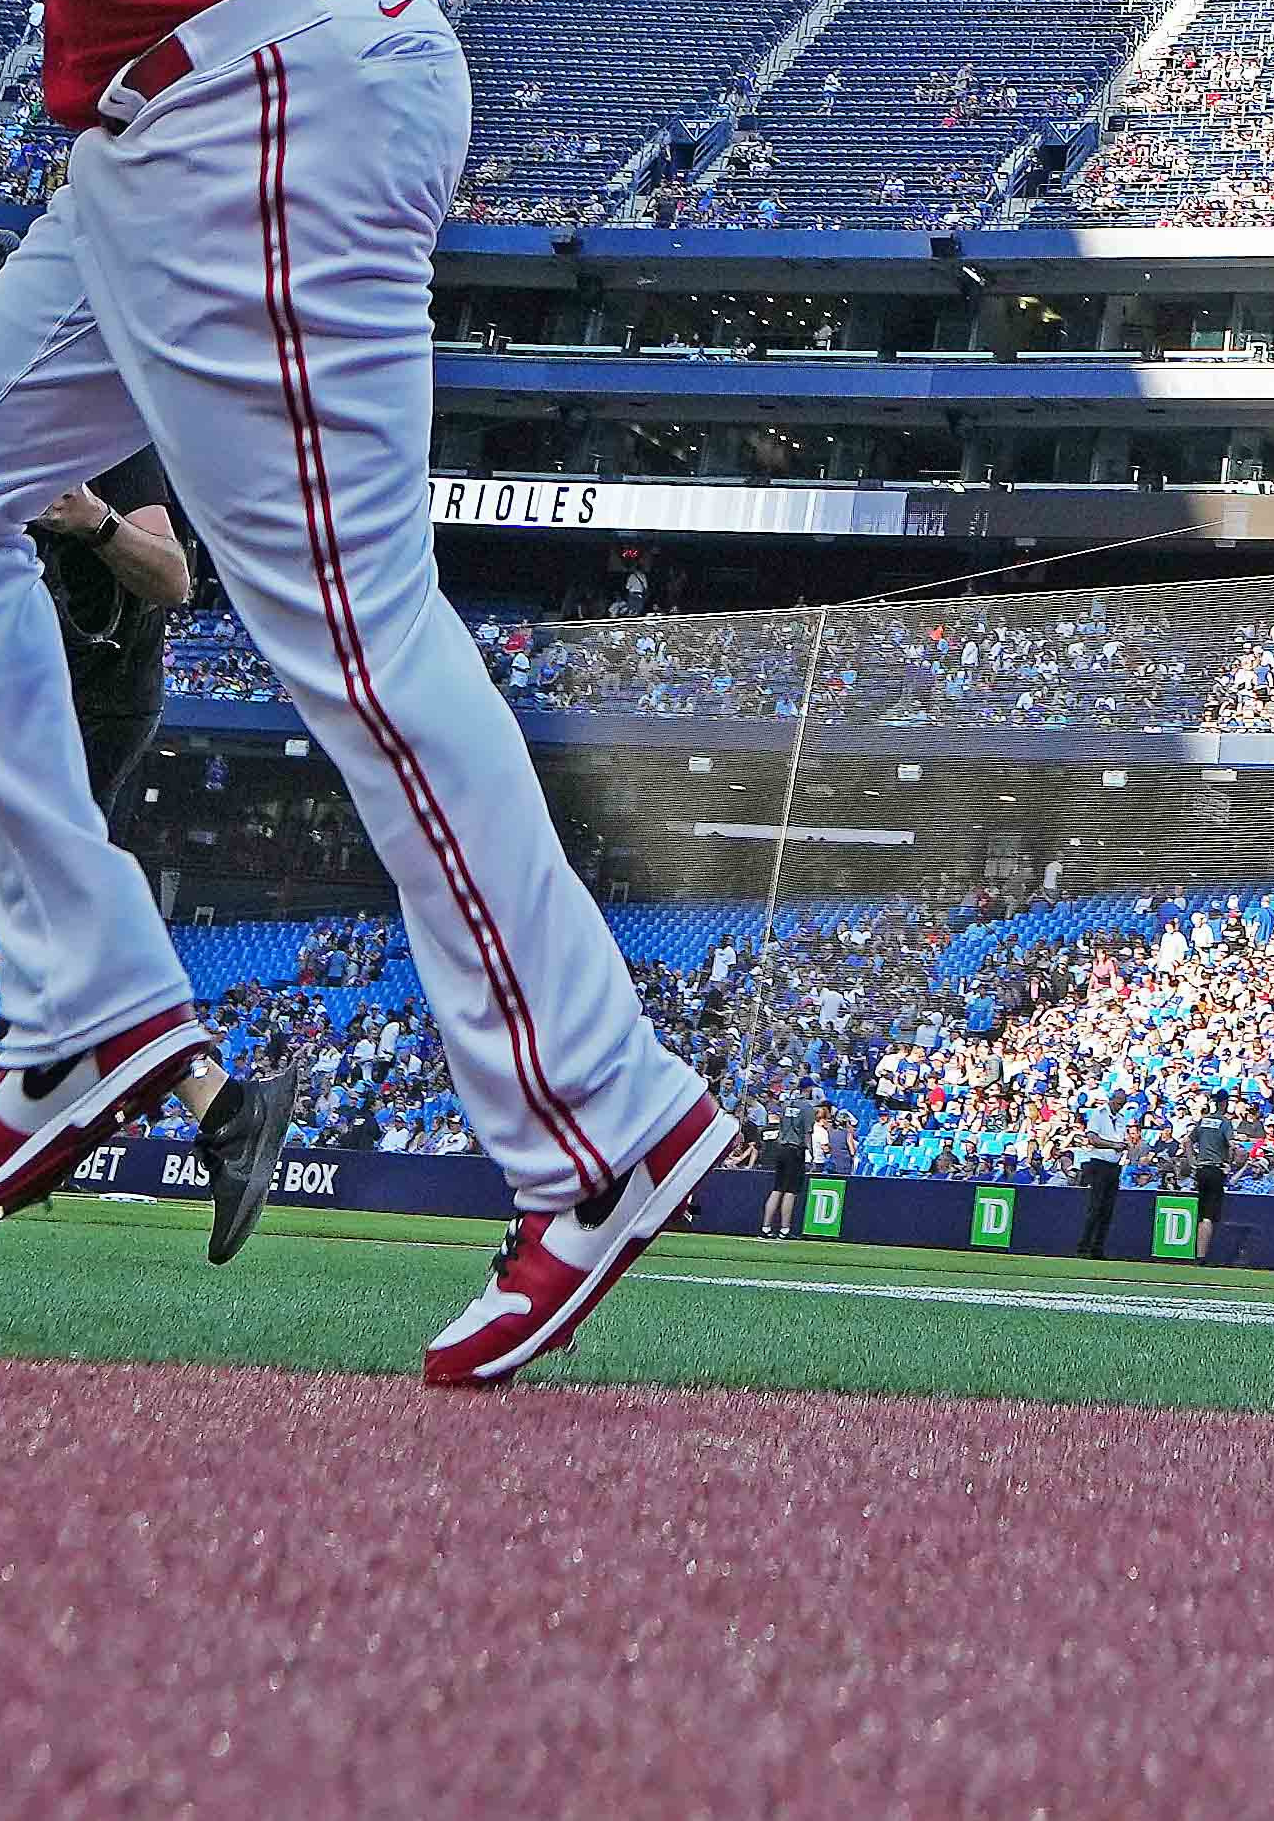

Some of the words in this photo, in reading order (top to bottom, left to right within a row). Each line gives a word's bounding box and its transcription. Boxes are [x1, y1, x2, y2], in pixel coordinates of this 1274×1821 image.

[74, 1146, 126, 1181] BET
[284, 1161, 339, 1195] BOX
[811, 1189, 839, 1224] TD
[980, 1198, 1010, 1234] TD
[1159, 1207, 1193, 1246] TD
